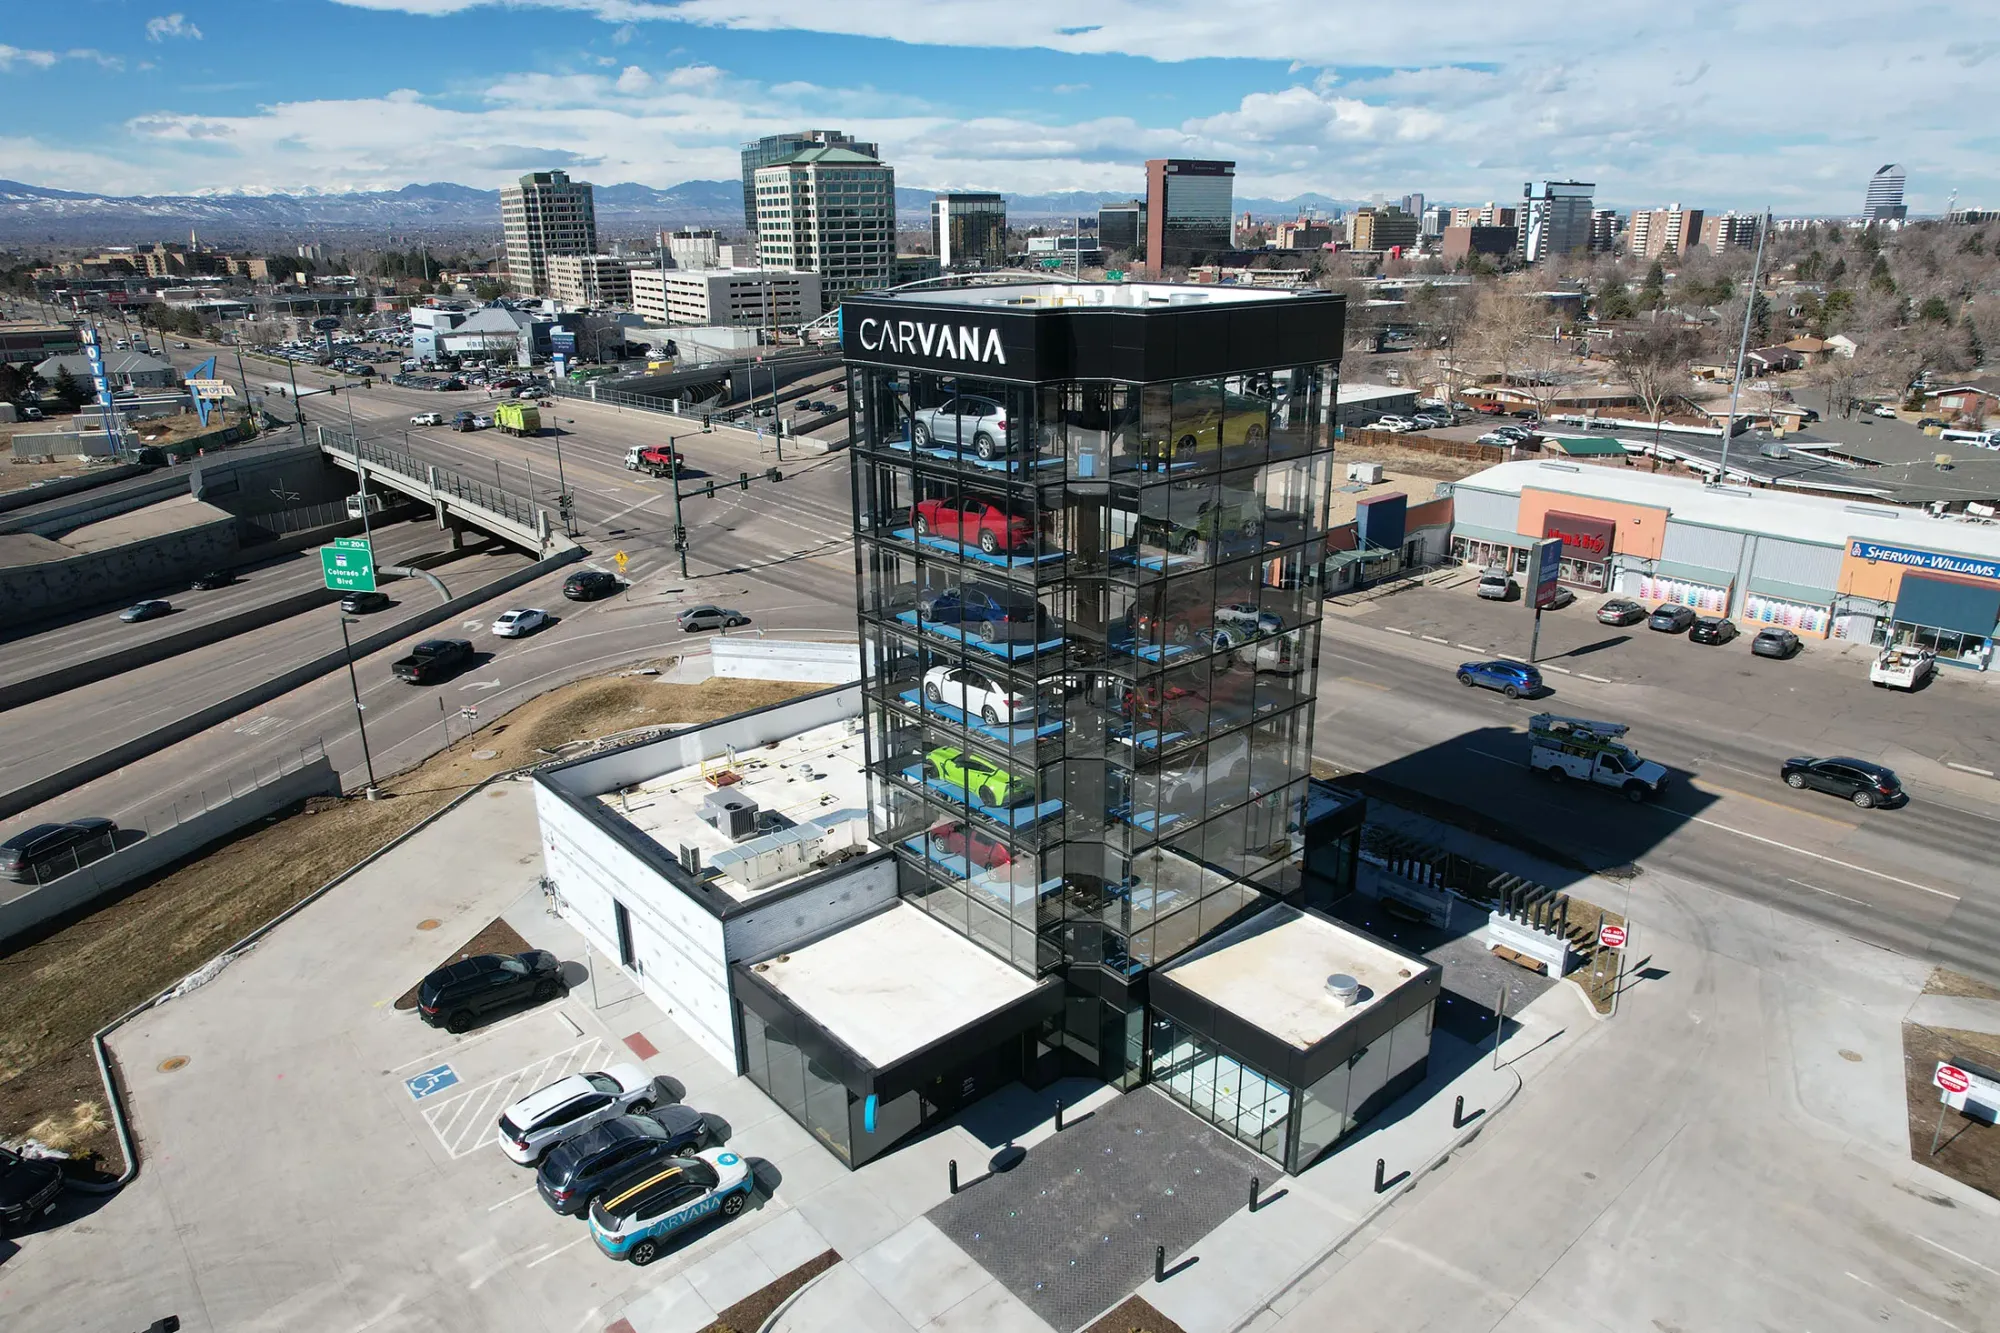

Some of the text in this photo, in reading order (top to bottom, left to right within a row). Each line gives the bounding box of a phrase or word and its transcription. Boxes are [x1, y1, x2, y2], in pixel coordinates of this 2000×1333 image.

[860, 318, 1006, 364] CARVANA
[81, 329, 109, 406] MOTEL
[1572, 534, 1580, 548] &
[1866, 547, 1995, 576] SHERWIN-WILLIAMS
[327, 568, 359, 577] Colorado
[336, 577, 353, 585] Blvd
[1942, 1079, 1960, 1090] ENTER
[648, 1197, 720, 1237] CARVANA
